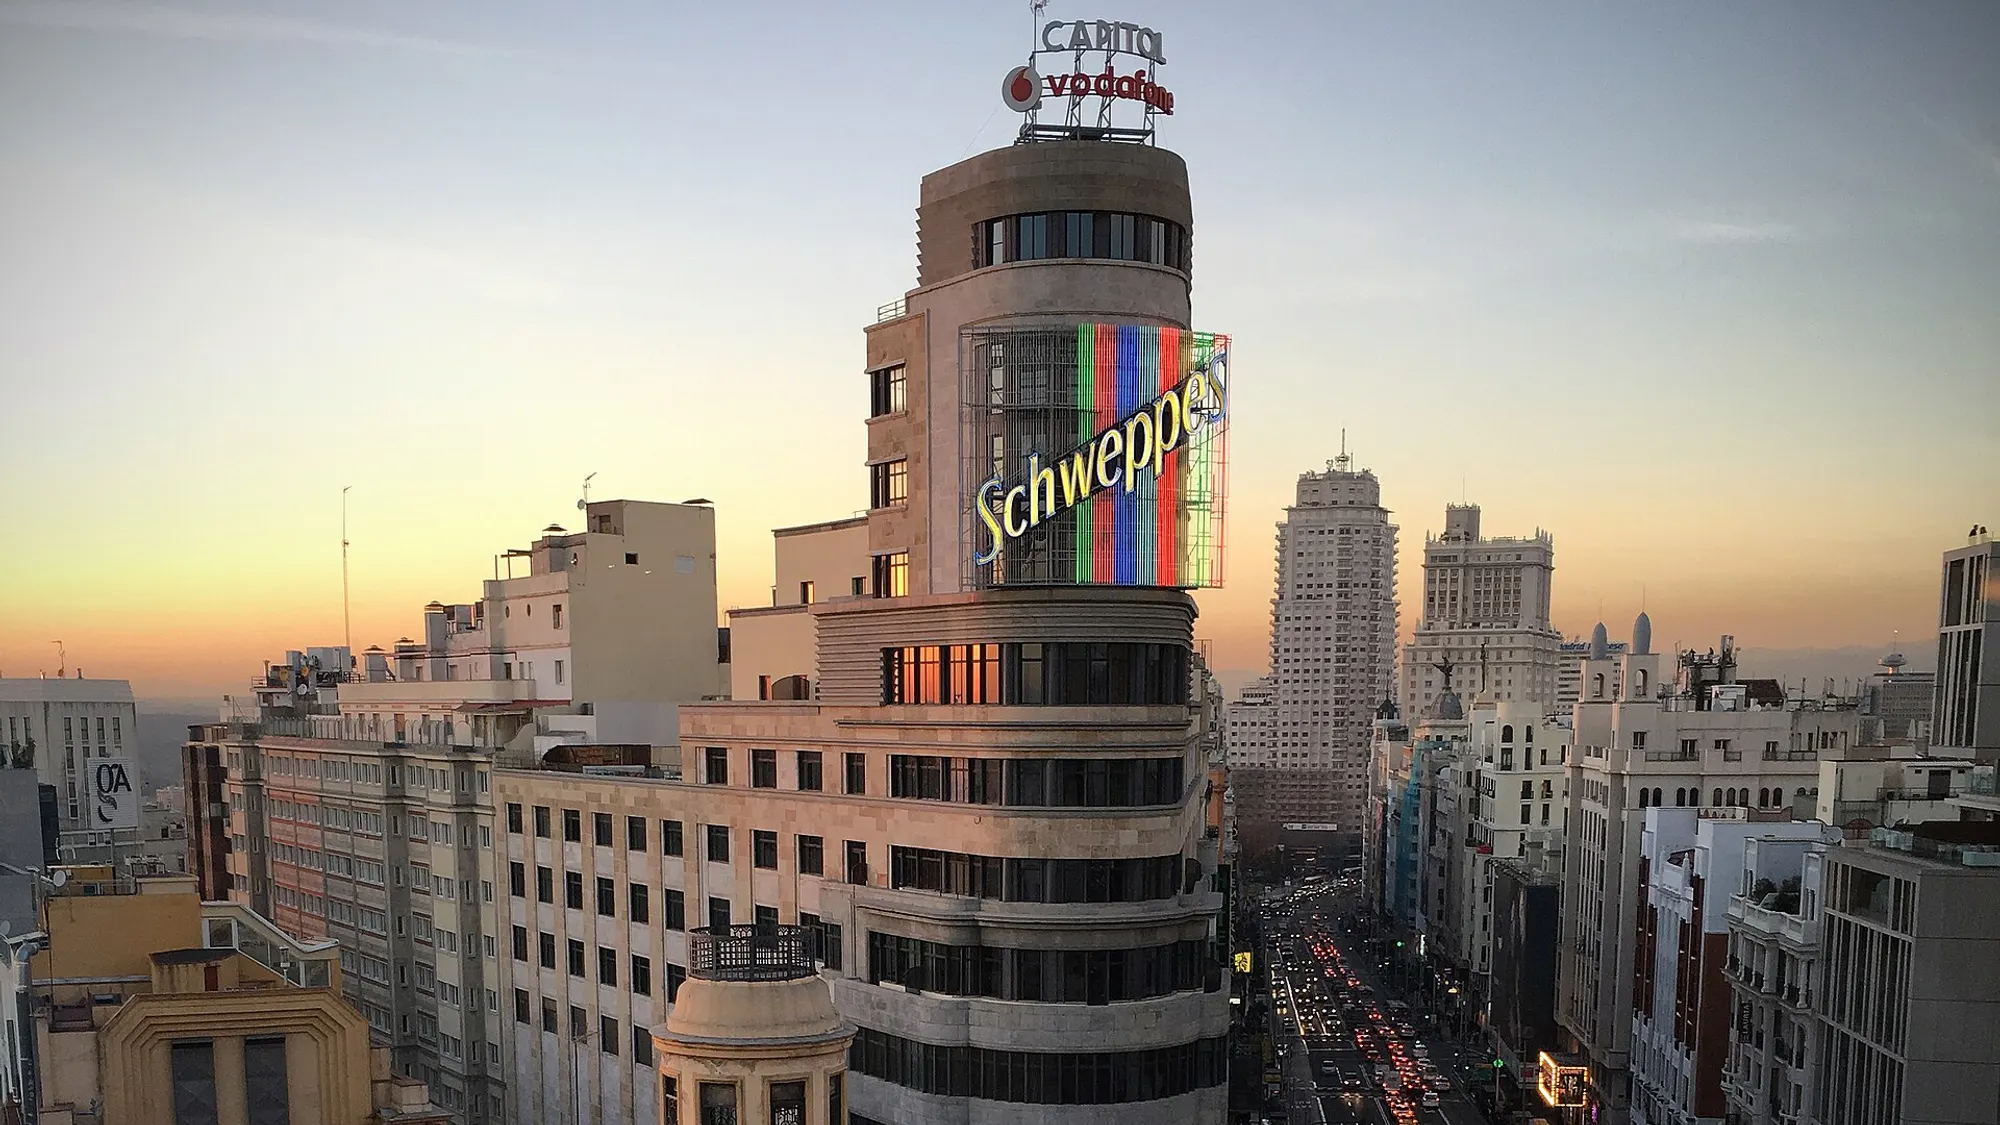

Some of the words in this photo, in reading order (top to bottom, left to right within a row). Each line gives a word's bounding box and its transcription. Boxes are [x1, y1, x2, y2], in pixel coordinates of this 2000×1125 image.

[1042, 20, 1163, 59] CAPITOL
[1047, 66, 1174, 115] vodafone
[975, 351, 1227, 565] Schweppes
